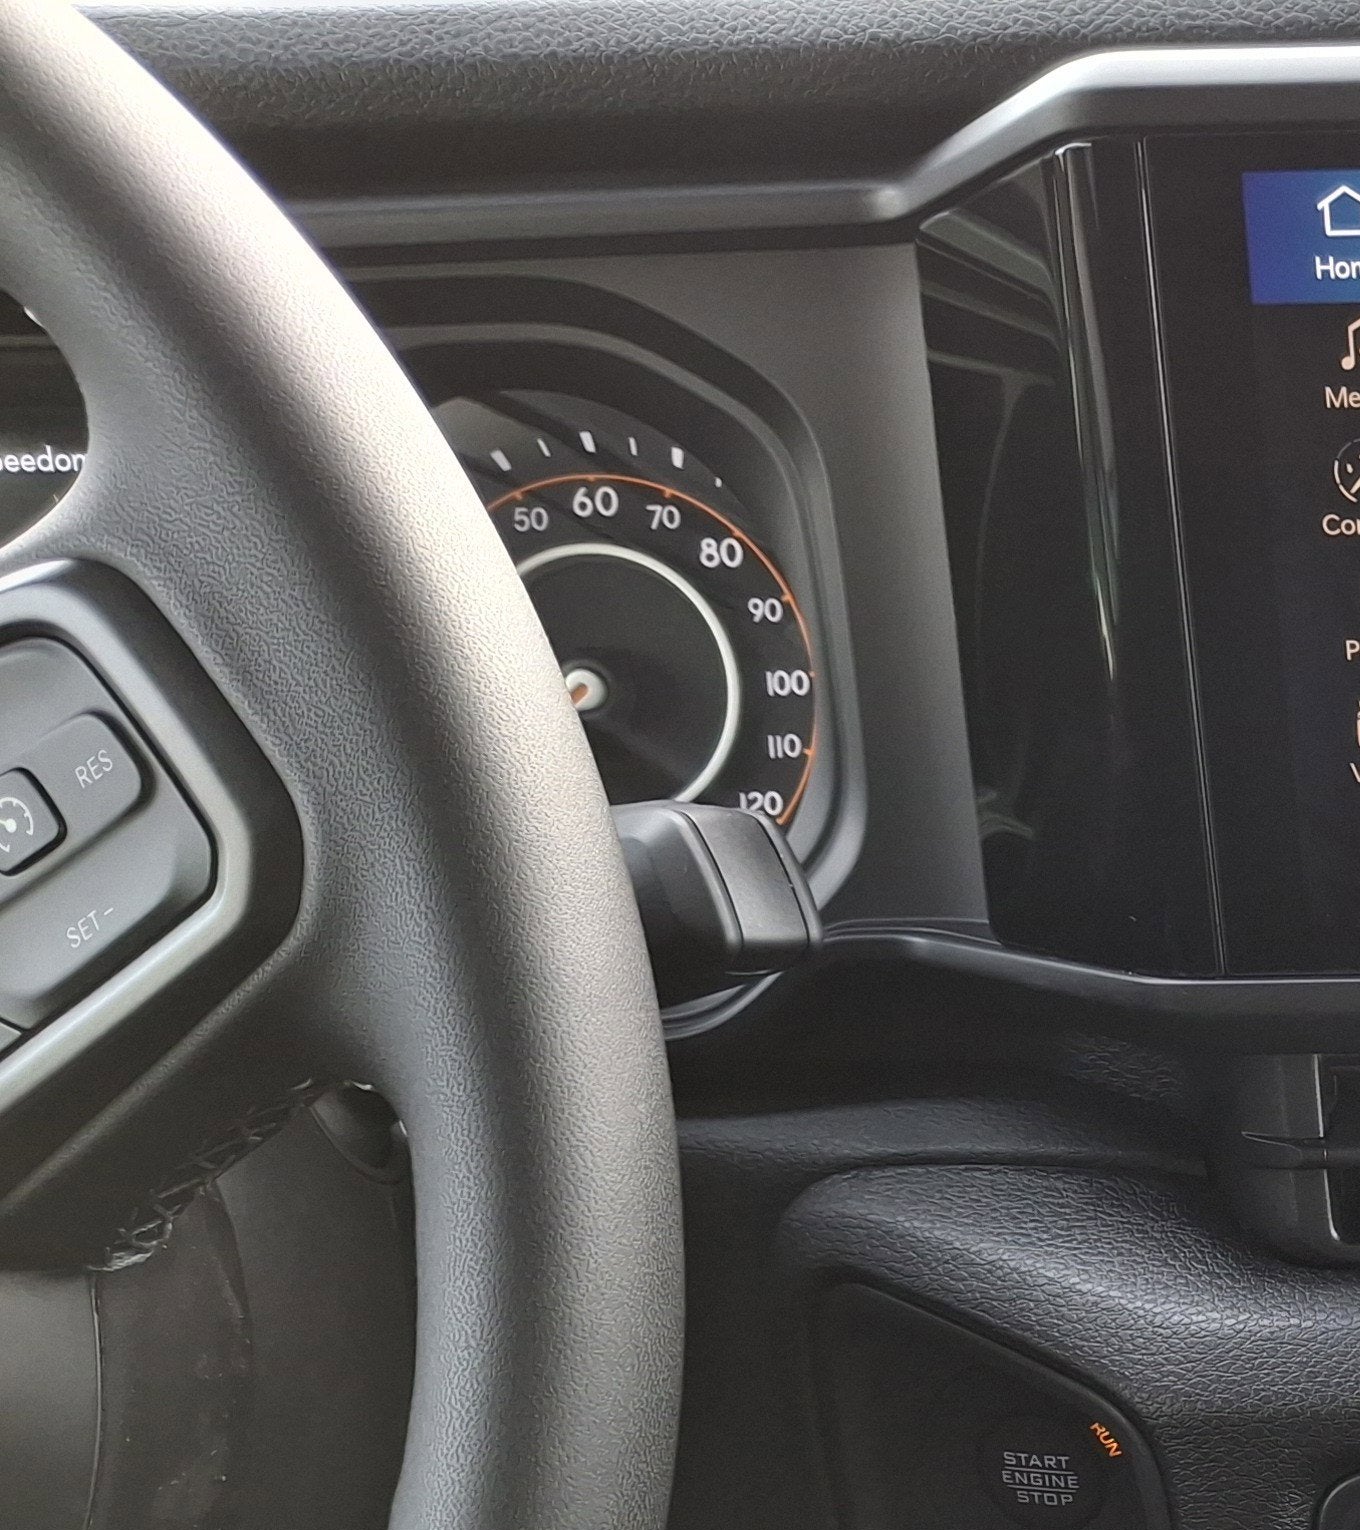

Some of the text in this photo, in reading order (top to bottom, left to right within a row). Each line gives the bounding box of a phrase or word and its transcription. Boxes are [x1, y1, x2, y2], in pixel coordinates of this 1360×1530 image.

[573, 487, 619, 517] 60
[513, 507, 548, 532] 50
[646, 505, 681, 530] 70
[699, 538, 743, 568] 80
[748, 597, 783, 623] 90
[766, 669, 810, 697] 100
[768, 734, 800, 758] 110
[74, 749, 113, 788] RES
[1090, 1422, 1122, 1457] RUN
[1003, 1452, 1069, 1469] START
[1002, 1471, 1079, 1488] ENGINE
[1017, 1491, 1073, 1505] STOP
